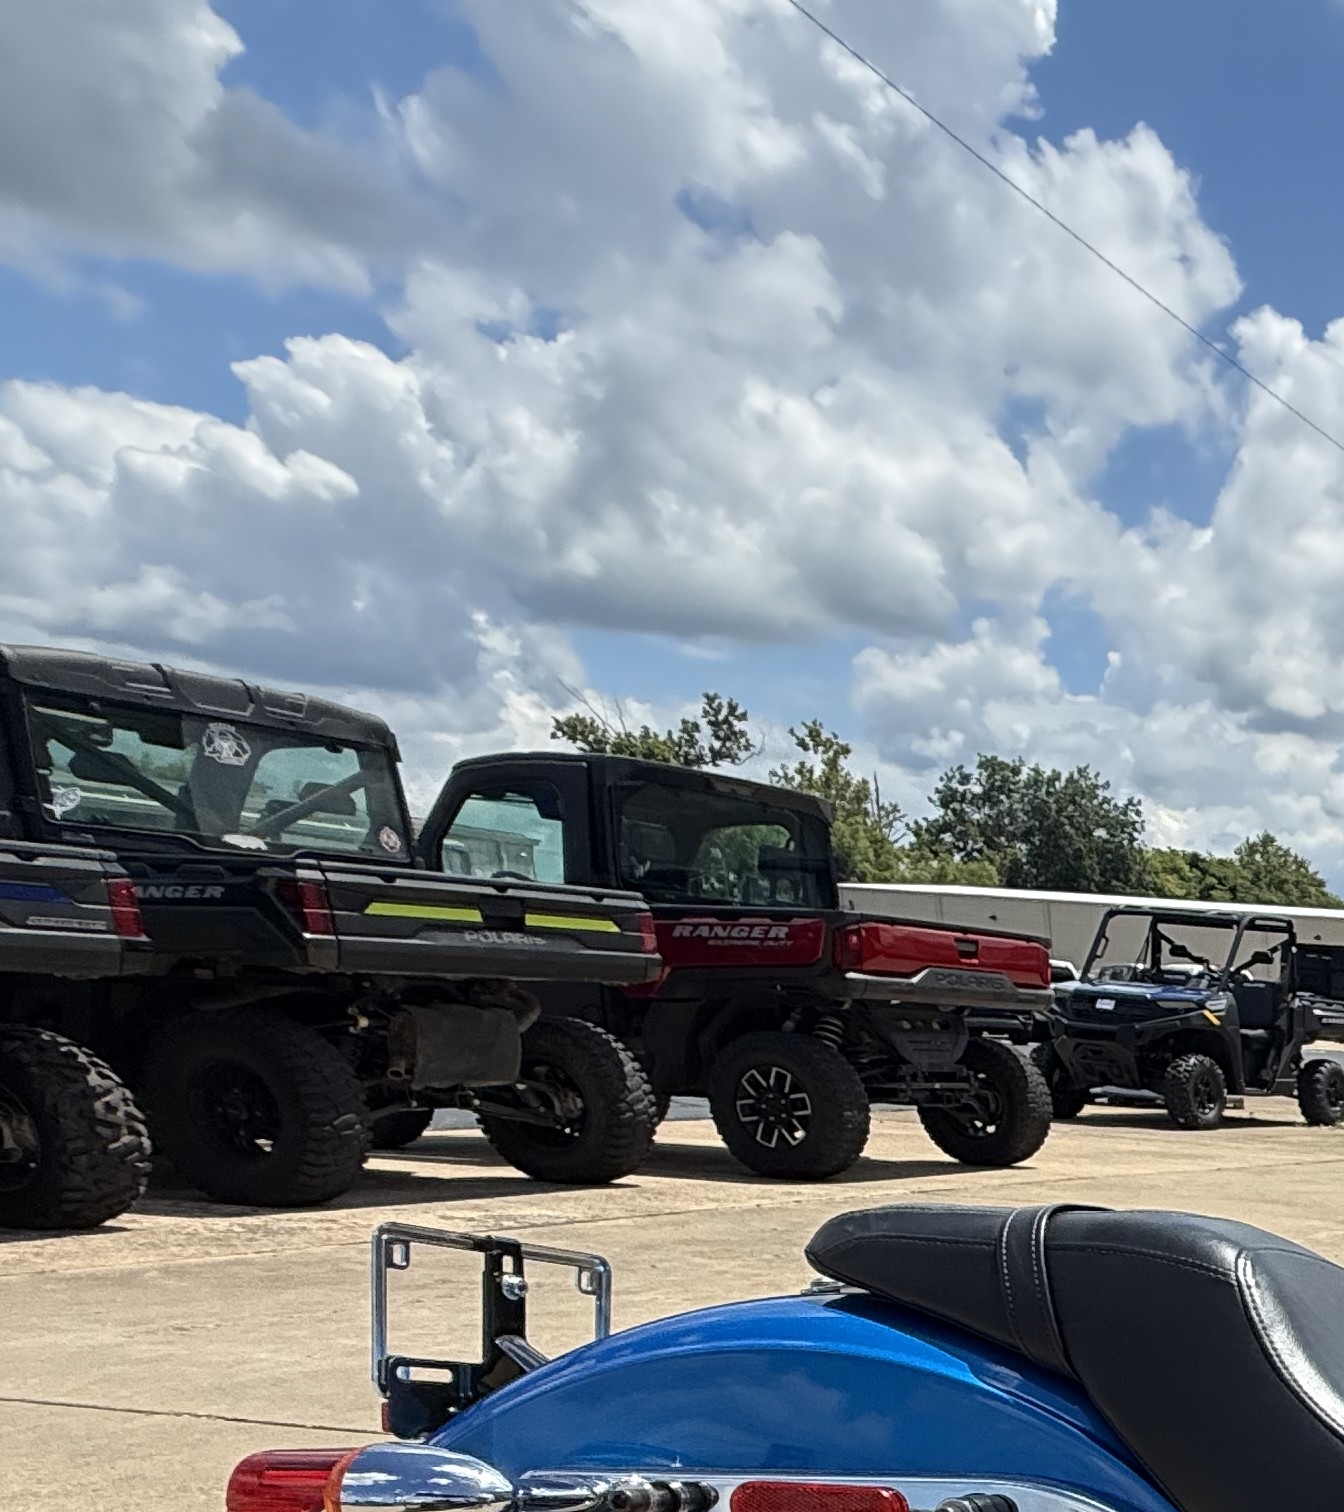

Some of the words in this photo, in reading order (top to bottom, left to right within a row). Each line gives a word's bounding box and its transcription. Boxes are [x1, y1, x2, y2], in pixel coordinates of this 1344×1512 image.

[134, 885, 225, 898] ANGER
[463, 930, 547, 945] POLARIS
[671, 925, 789, 938] RANGER
[935, 973, 1005, 991] POLARIS
